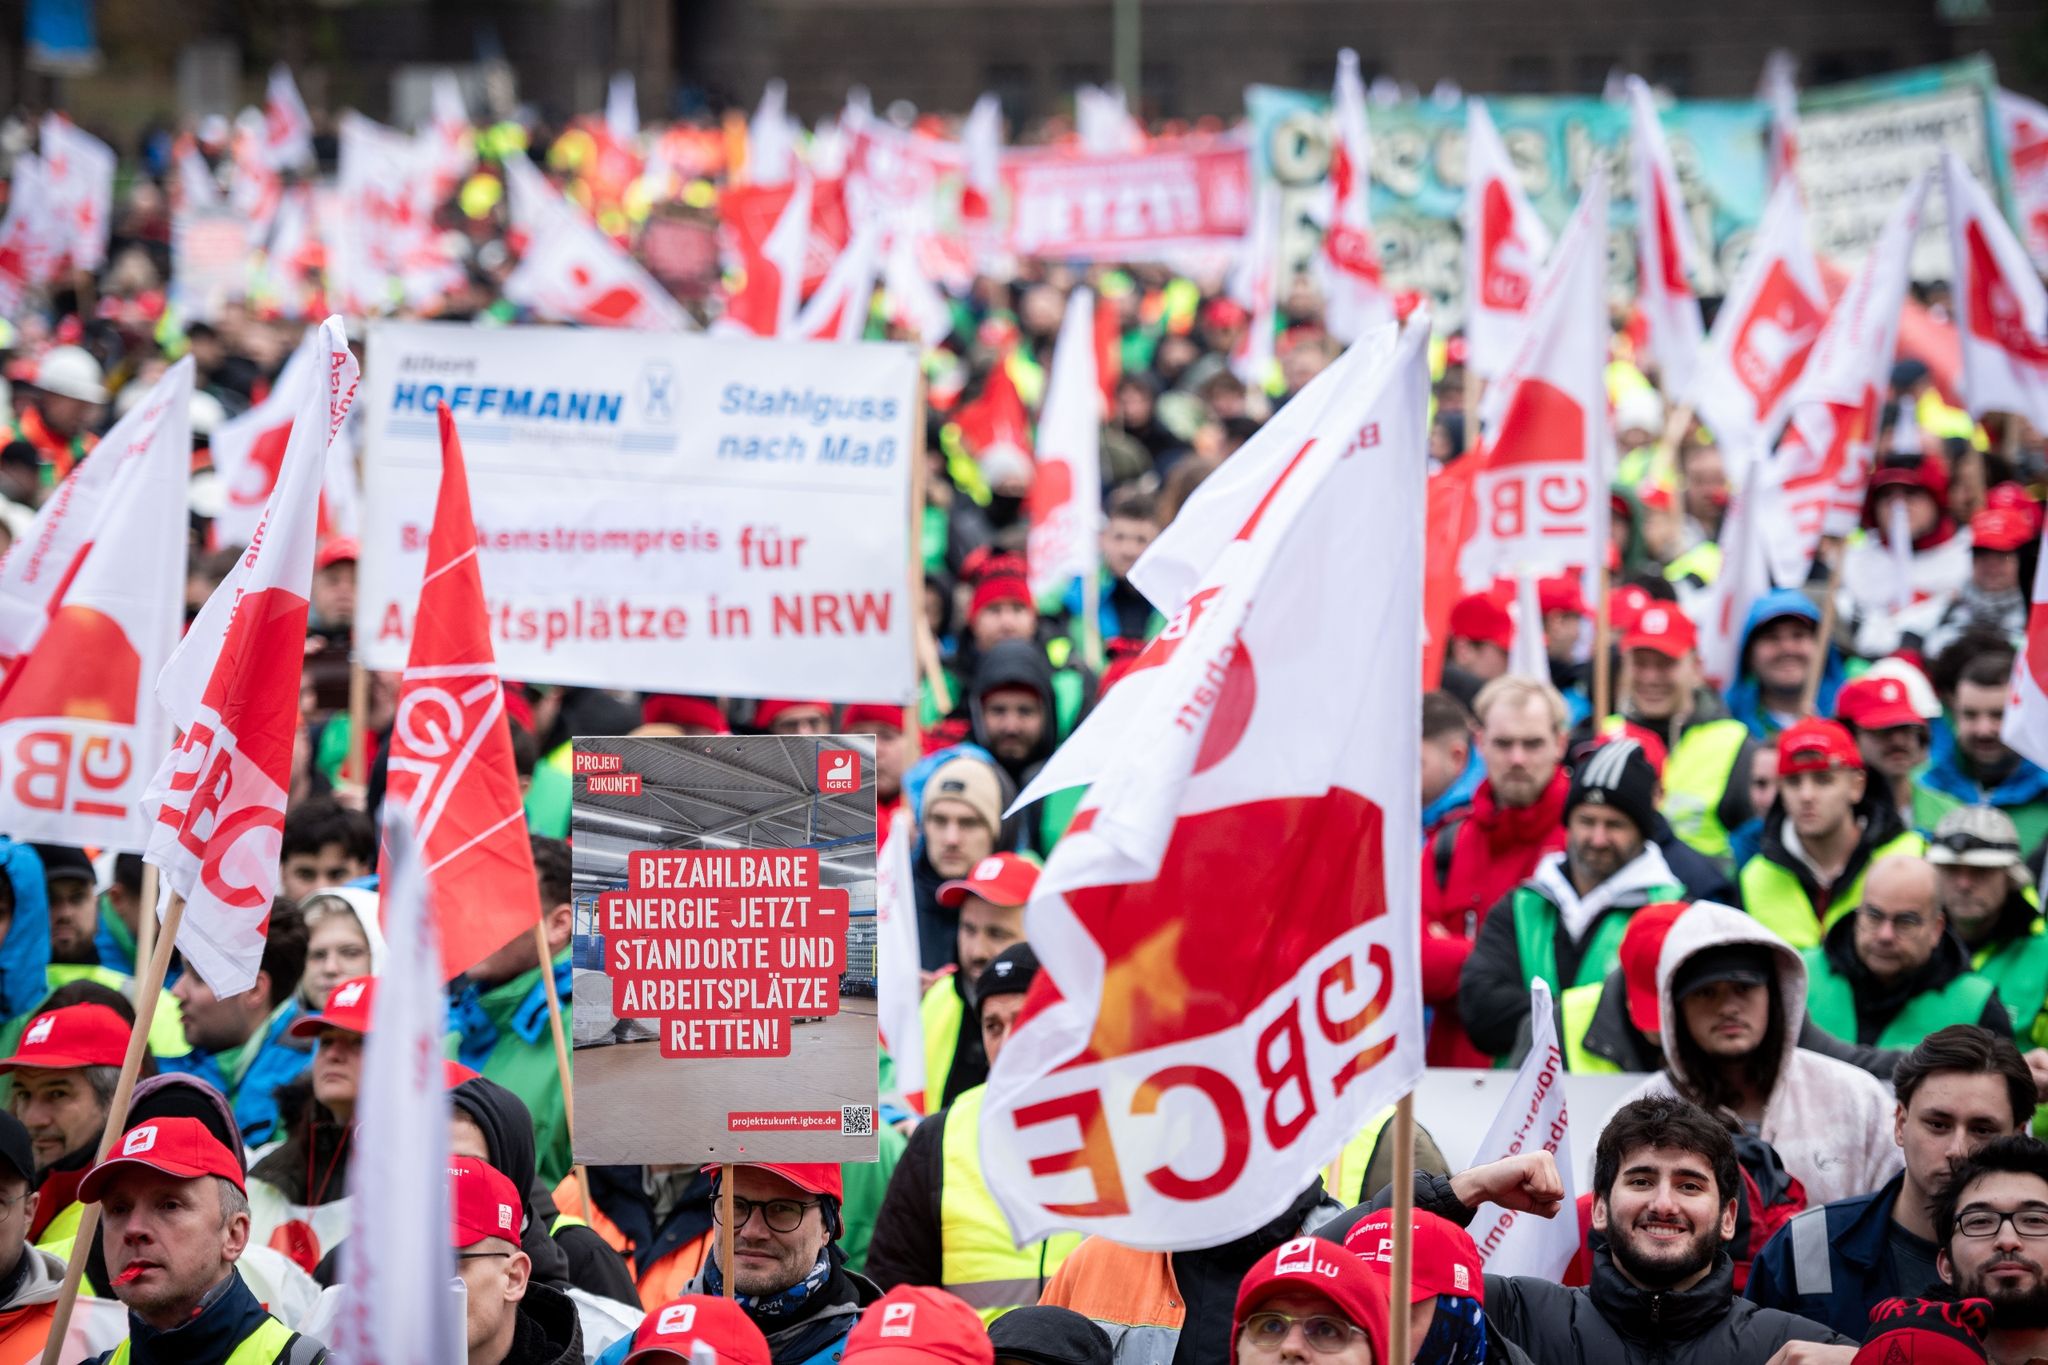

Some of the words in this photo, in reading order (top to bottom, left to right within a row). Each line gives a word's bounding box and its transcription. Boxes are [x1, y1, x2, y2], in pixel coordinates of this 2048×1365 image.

[393, 382, 624, 424] HOFFMANN
[719, 384, 898, 425] Stahlguss
[718, 434, 804, 461] nach
[817, 435, 897, 467] Maß
[741, 526, 806, 567] für
[710, 594, 752, 636] in
[772, 592, 891, 634] NRW
[576, 755, 620, 771] PROJEKT
[589, 776, 638, 793] ZUKUNFT
[826, 780, 853, 789] IGBCE
[640, 856, 808, 889] BEZAHLBARE
[609, 898, 719, 930] ENERGIE
[731, 897, 811, 929] JETZT
[615, 937, 769, 971] STANDORTE
[780, 937, 835, 968] UND
[622, 973, 828, 1011] ARBEITSPLÄTZE
[672, 1019, 779, 1051] RETTEN!
[732, 1115, 837, 1129] projektzukunft.igbce.de
[1316, 1260, 1339, 1277] LU
